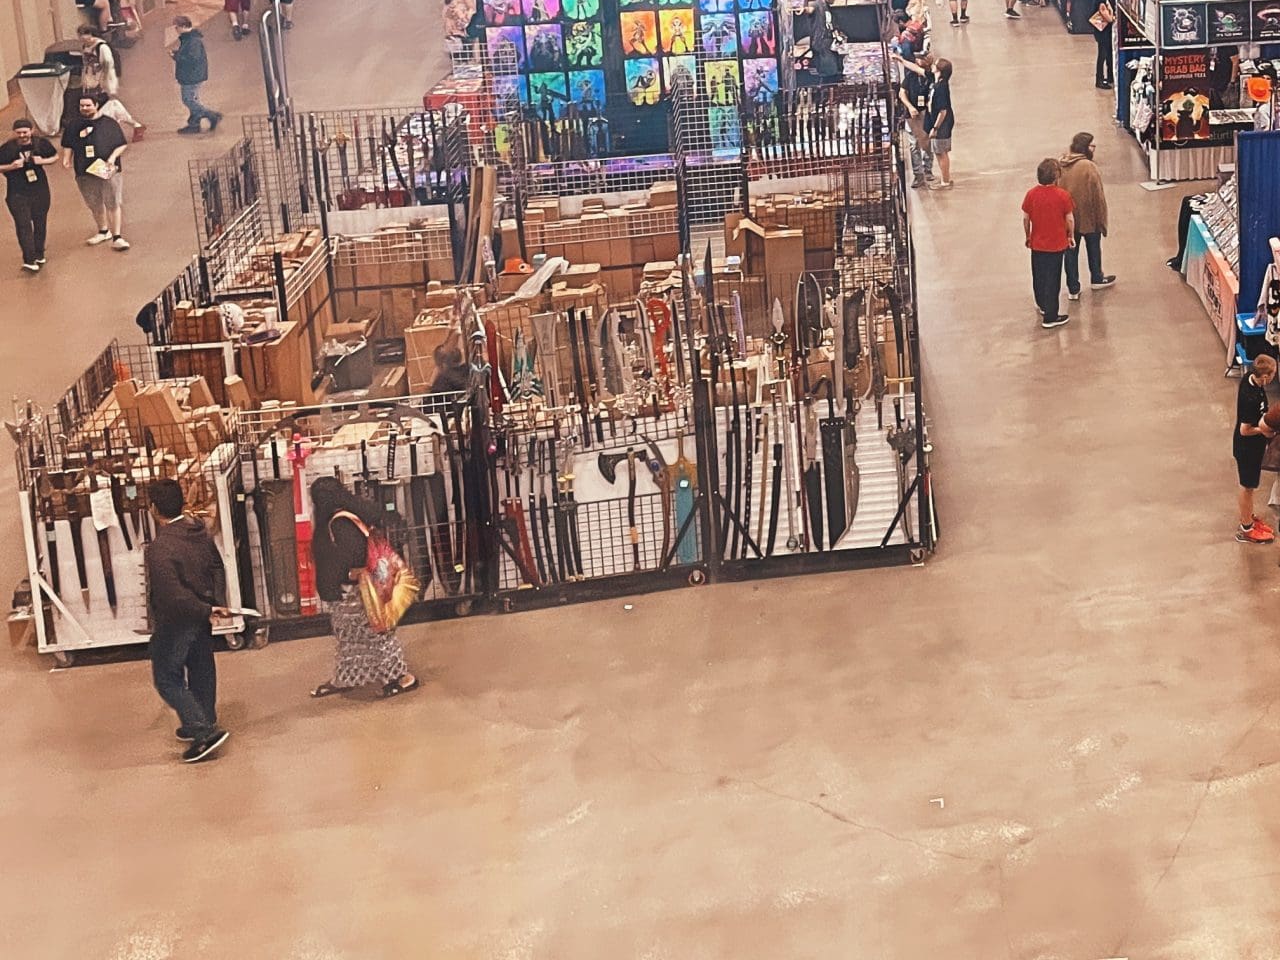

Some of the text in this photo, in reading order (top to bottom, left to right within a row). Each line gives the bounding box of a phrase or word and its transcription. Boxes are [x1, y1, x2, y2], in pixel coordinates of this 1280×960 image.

[1164, 54, 1206, 65] MYSTERY
[1164, 63, 1207, 74] GRAB BAG
